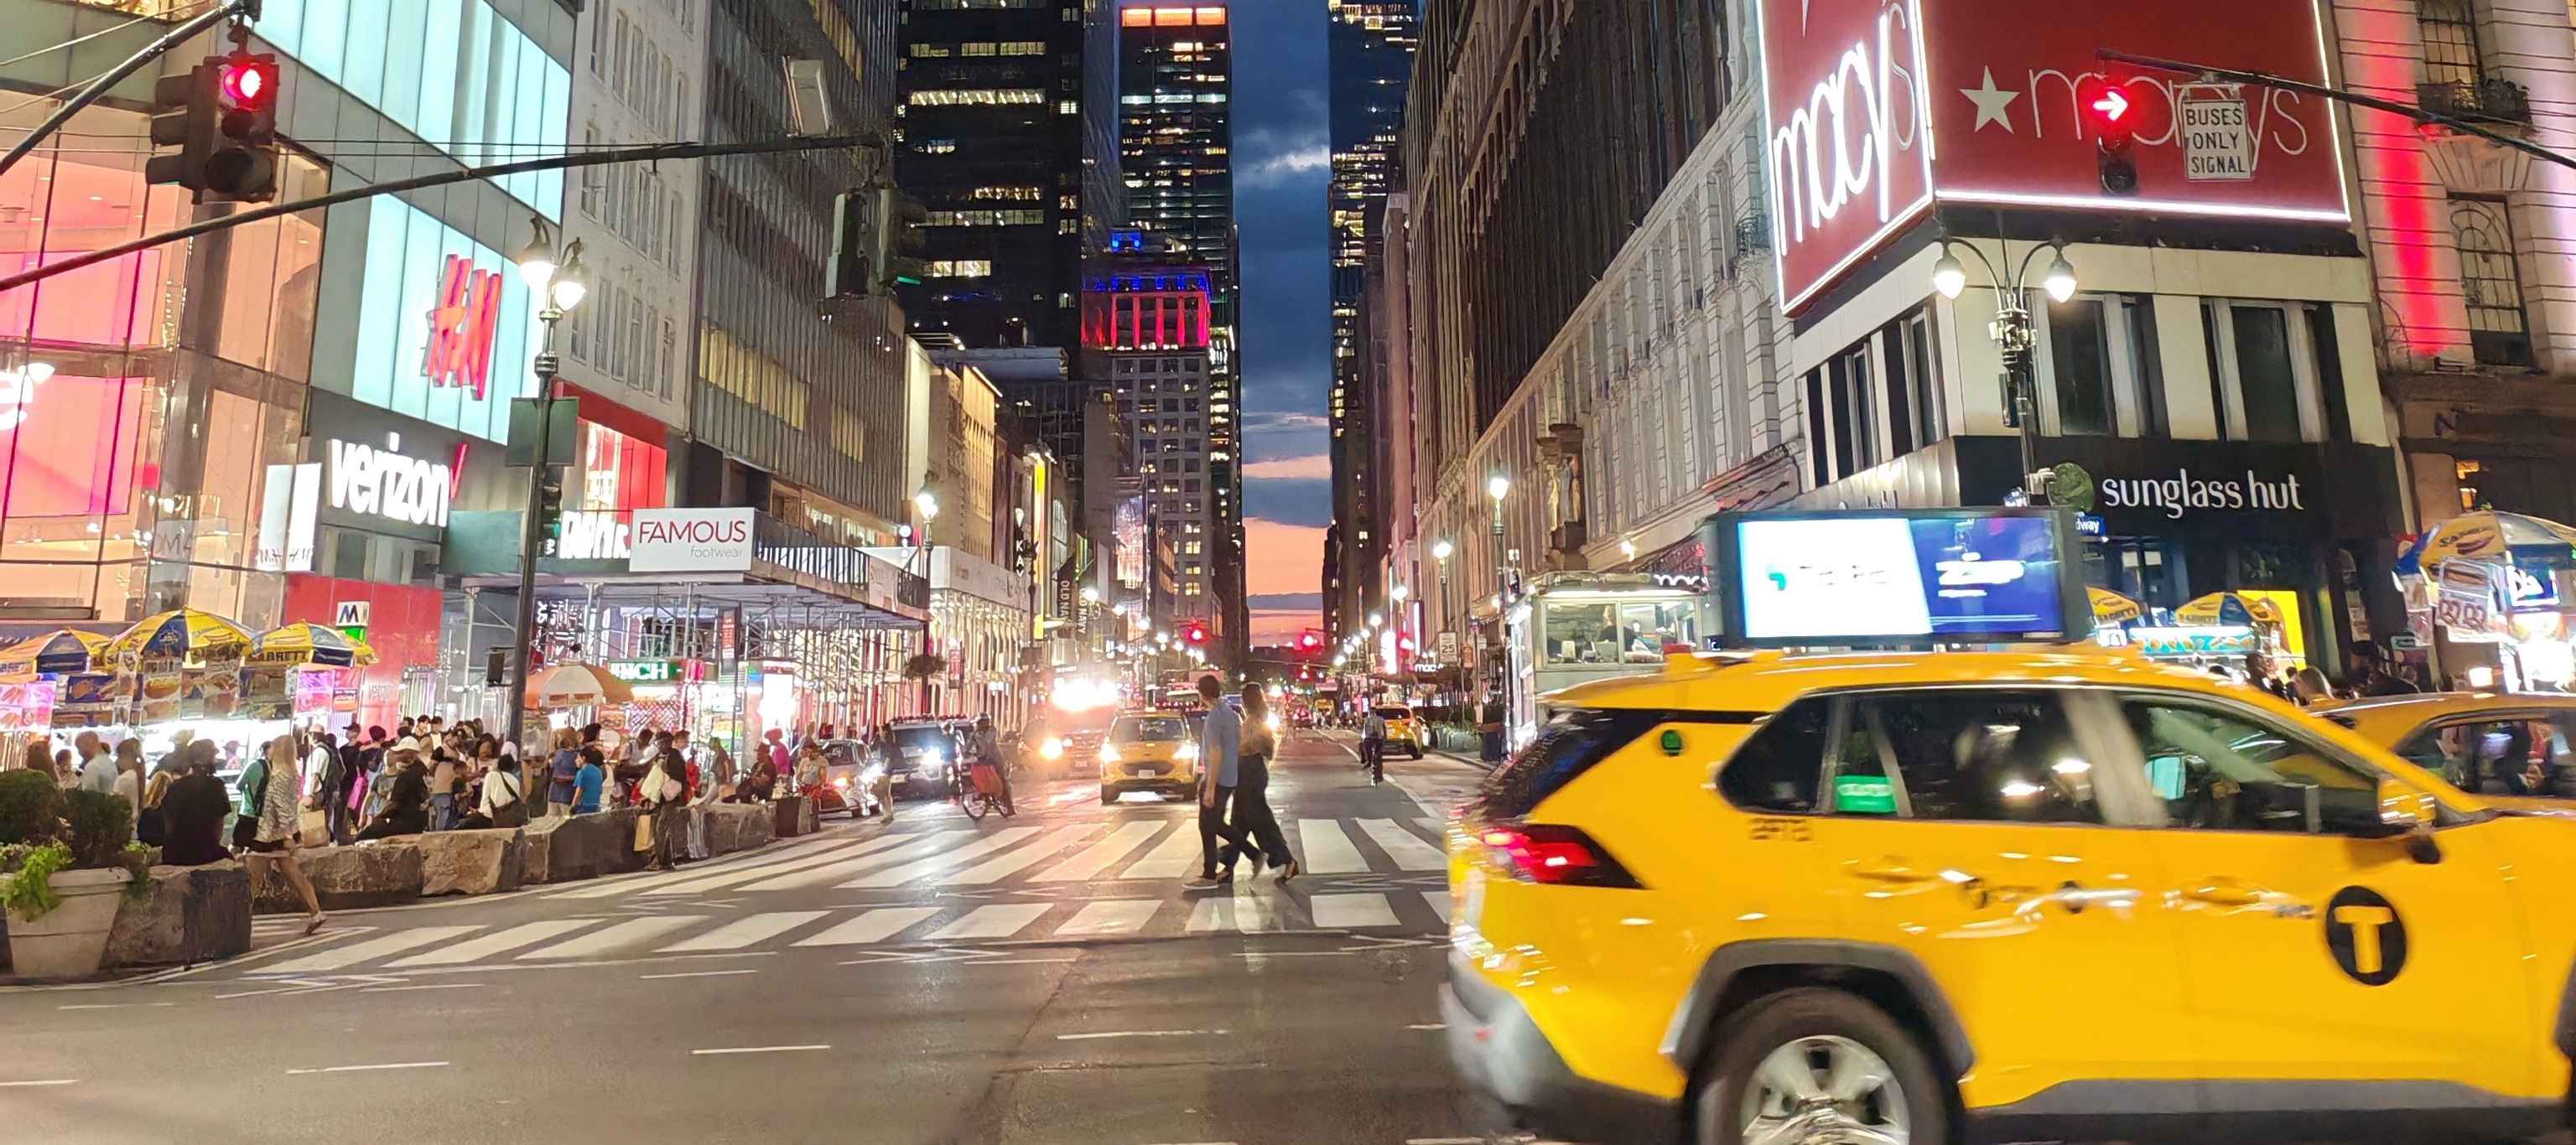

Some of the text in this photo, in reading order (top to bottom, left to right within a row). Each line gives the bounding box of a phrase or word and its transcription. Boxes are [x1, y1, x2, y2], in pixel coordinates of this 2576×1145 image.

[2185, 107, 2243, 127] BUSES
[2193, 132, 2239, 151] ONLY
[2191, 156, 2246, 174] SIGNAL
[328, 431, 449, 528] verizon
[2101, 468, 2305, 520] sunglass hut
[638, 520, 746, 544] FAMOUS
[690, 546, 743, 559] footwear
[1441, 644, 1456, 654] 25
[2334, 905, 2394, 974] T
